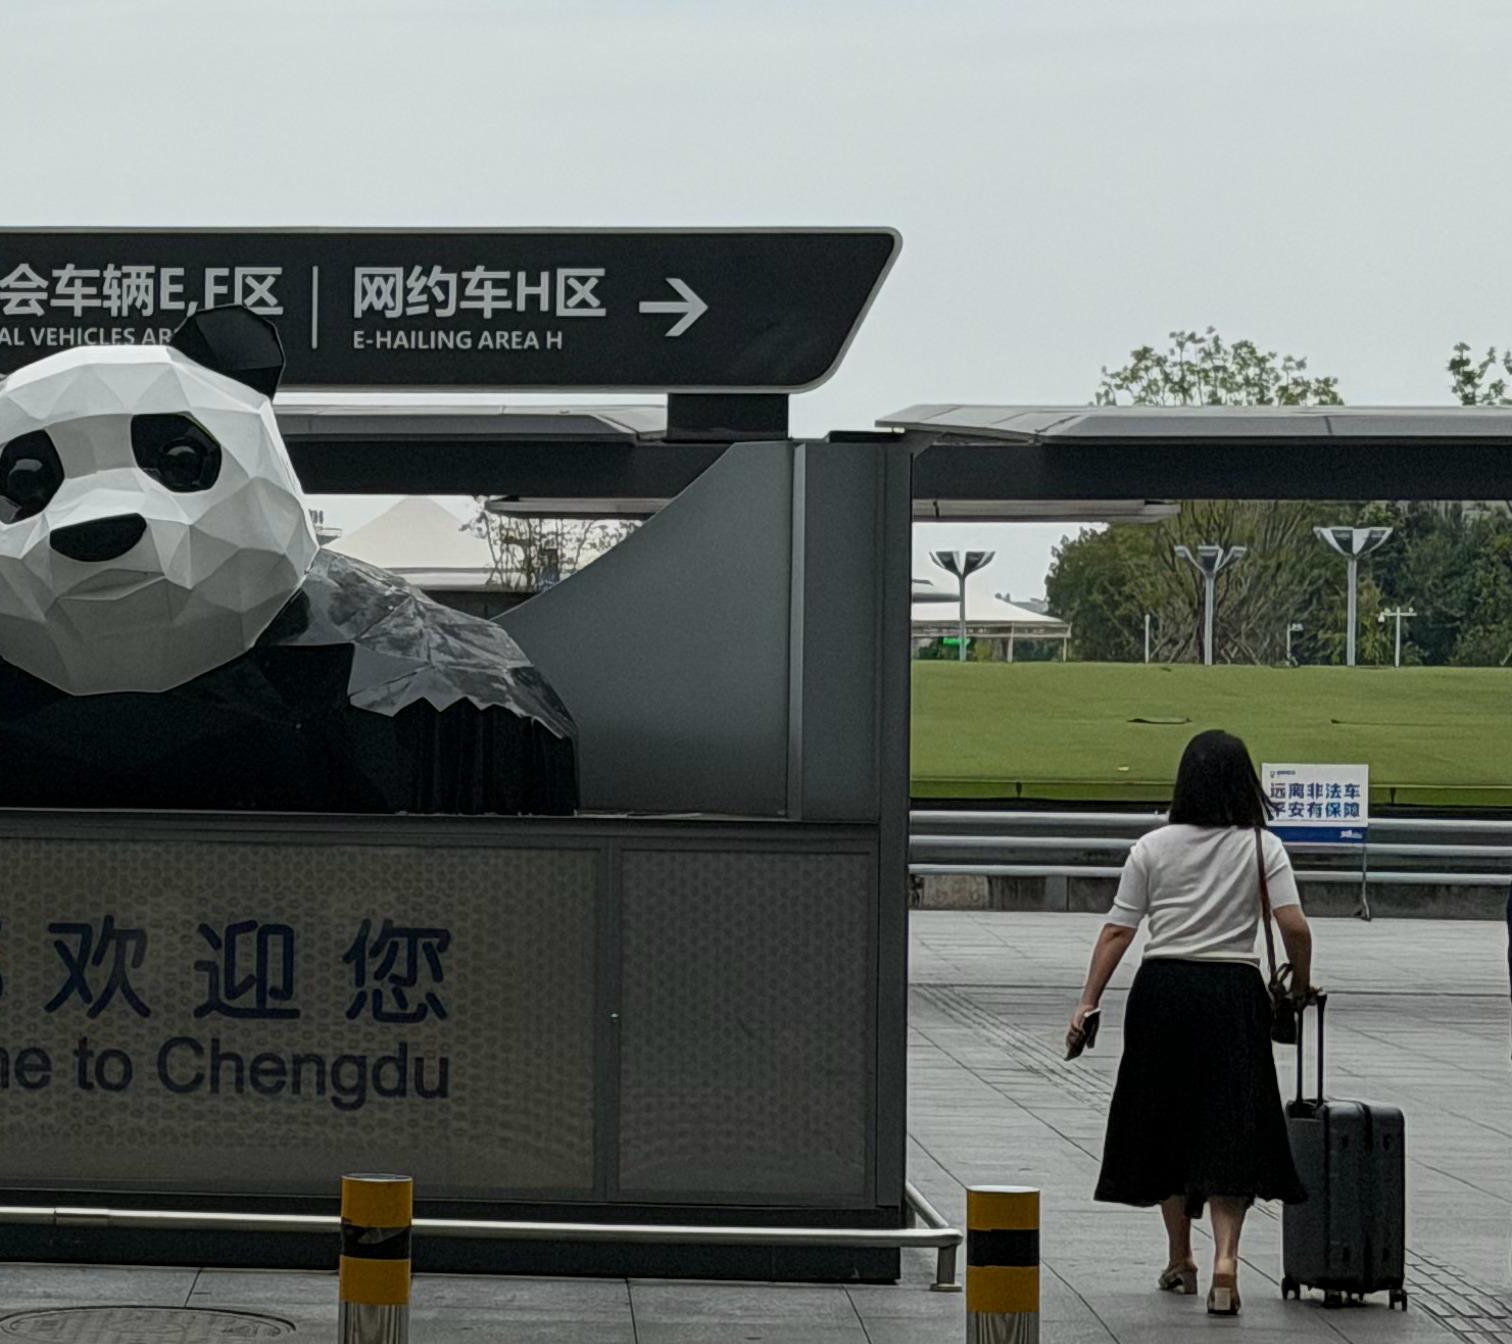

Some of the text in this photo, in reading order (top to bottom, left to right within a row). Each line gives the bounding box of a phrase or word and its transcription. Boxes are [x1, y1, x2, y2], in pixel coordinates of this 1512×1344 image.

[354, 265, 607, 319] 网约车H区
[30, 327, 136, 346] VEHICLES
[141, 327, 174, 345] AR
[353, 330, 563, 350] E-HAILING AREA H
[74, 1038, 134, 1093] to
[157, 1036, 450, 1112] Chengdu
